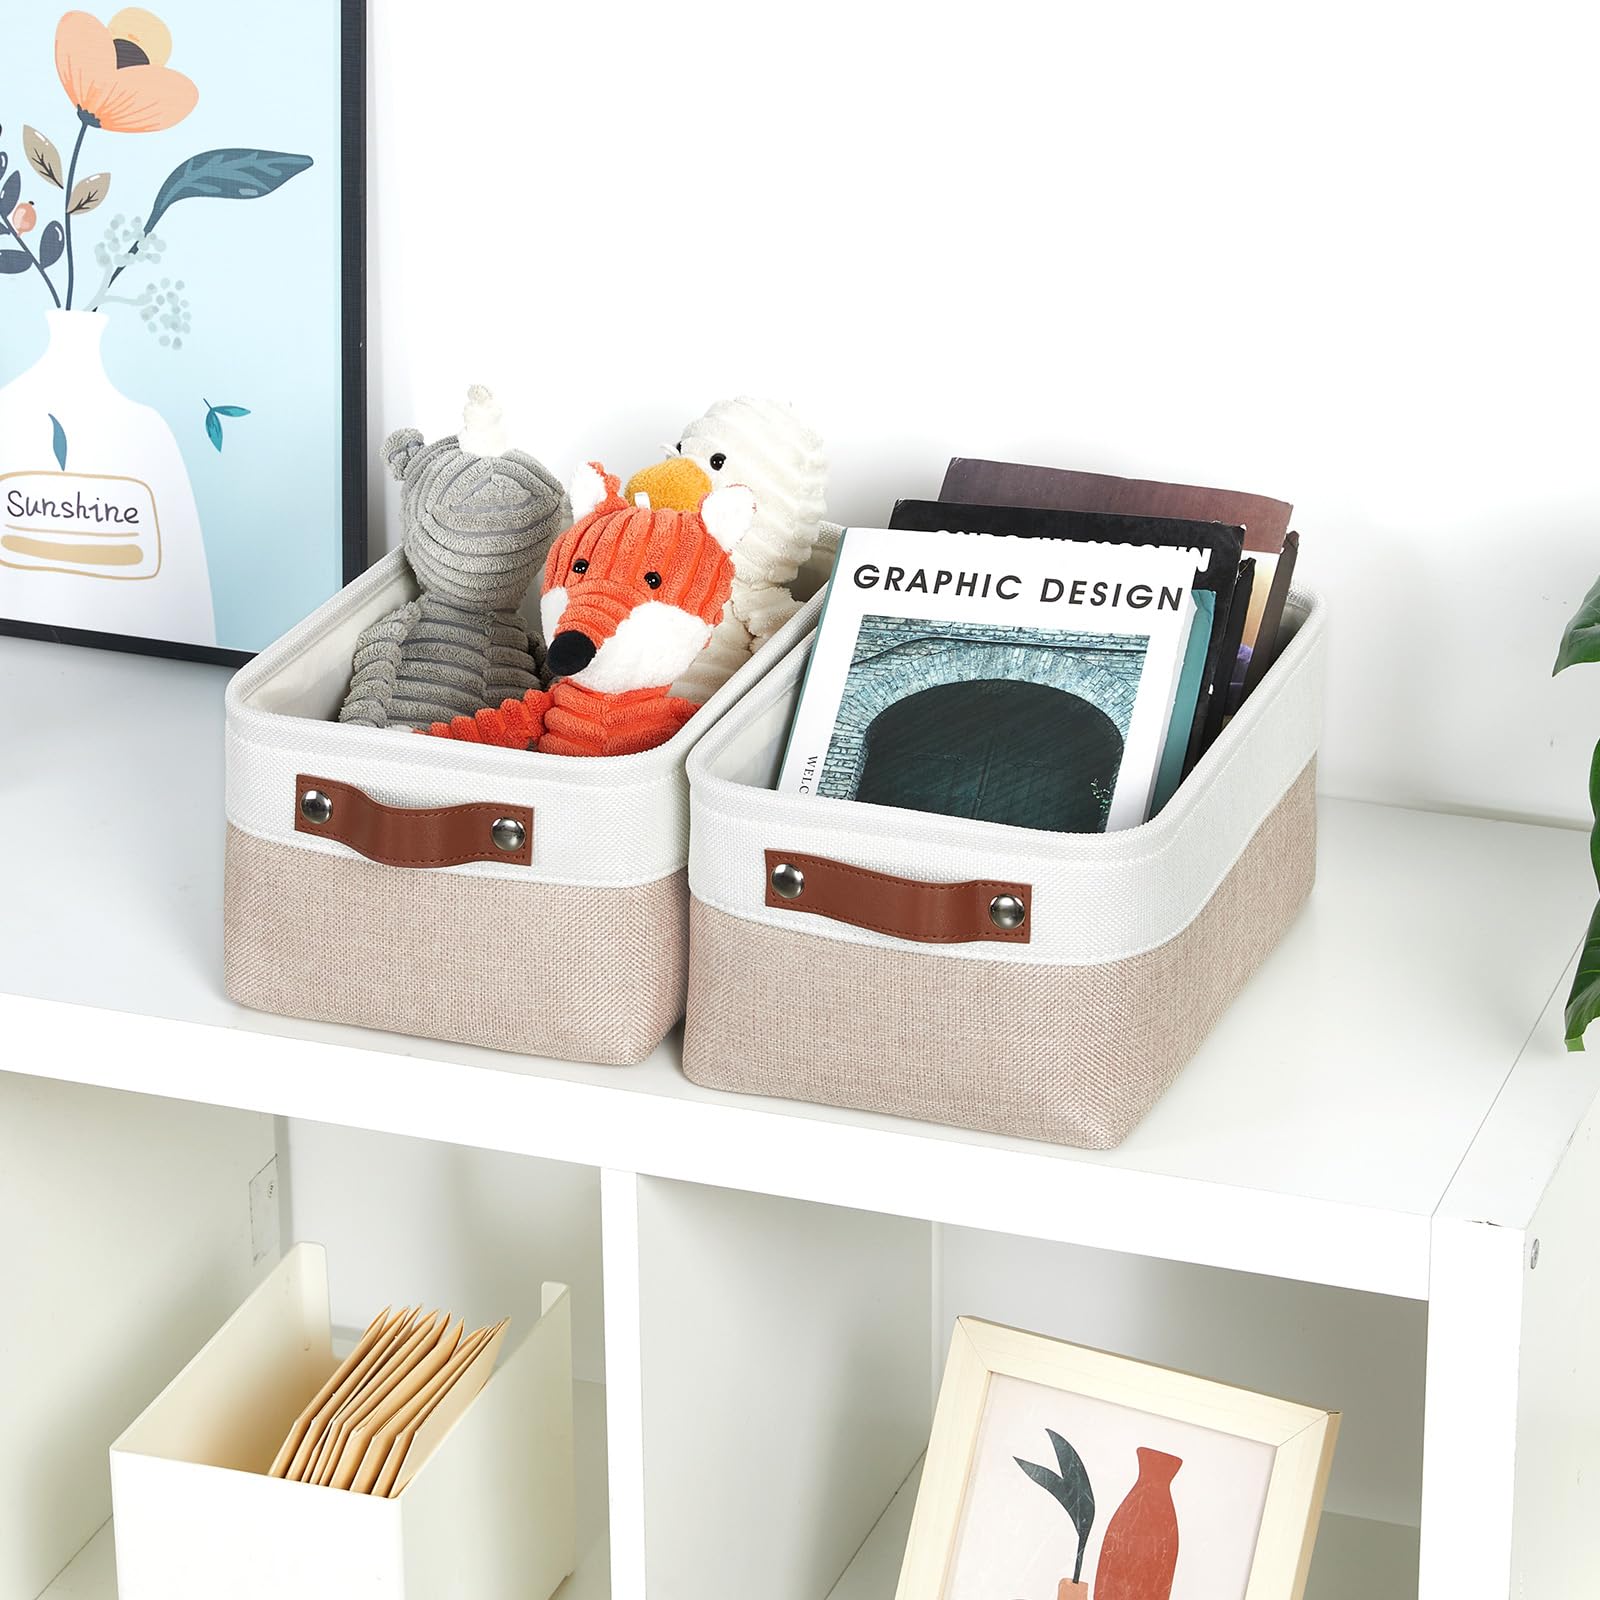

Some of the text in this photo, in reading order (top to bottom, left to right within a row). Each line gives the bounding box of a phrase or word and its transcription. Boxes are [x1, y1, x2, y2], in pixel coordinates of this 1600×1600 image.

[7, 490, 140, 524] Sunshine
[853, 564, 1184, 612] GRAPHIC DESIGN
